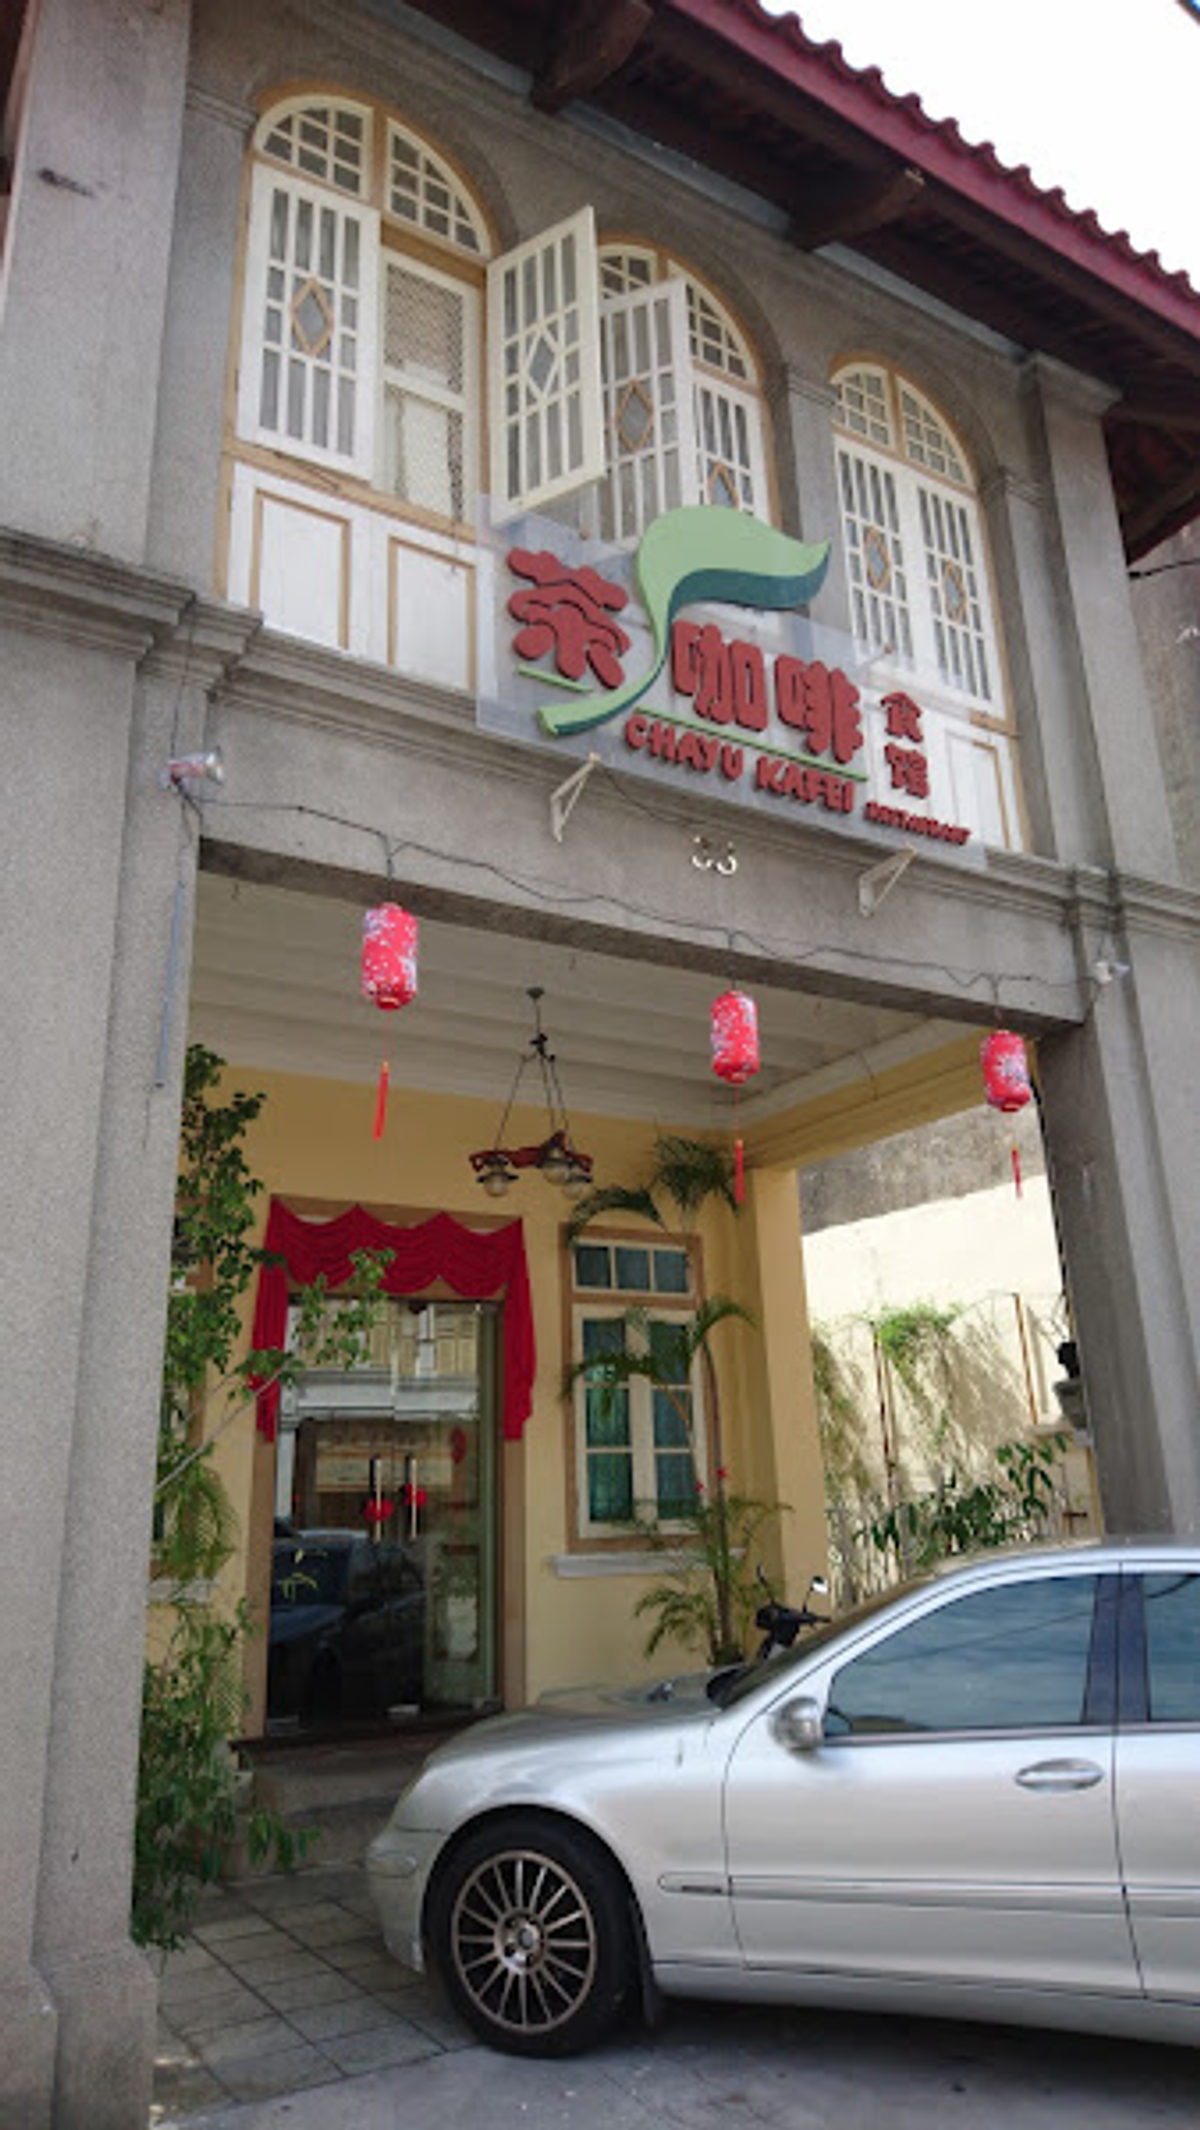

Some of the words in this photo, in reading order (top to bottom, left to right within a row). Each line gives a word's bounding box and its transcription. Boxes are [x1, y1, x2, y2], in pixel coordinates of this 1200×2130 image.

[507, 548, 631, 689] 茶
[672, 620, 864, 764] 咖啡
[625, 715, 744, 781] CHAYU
[756, 756, 863, 813] KAFEI
